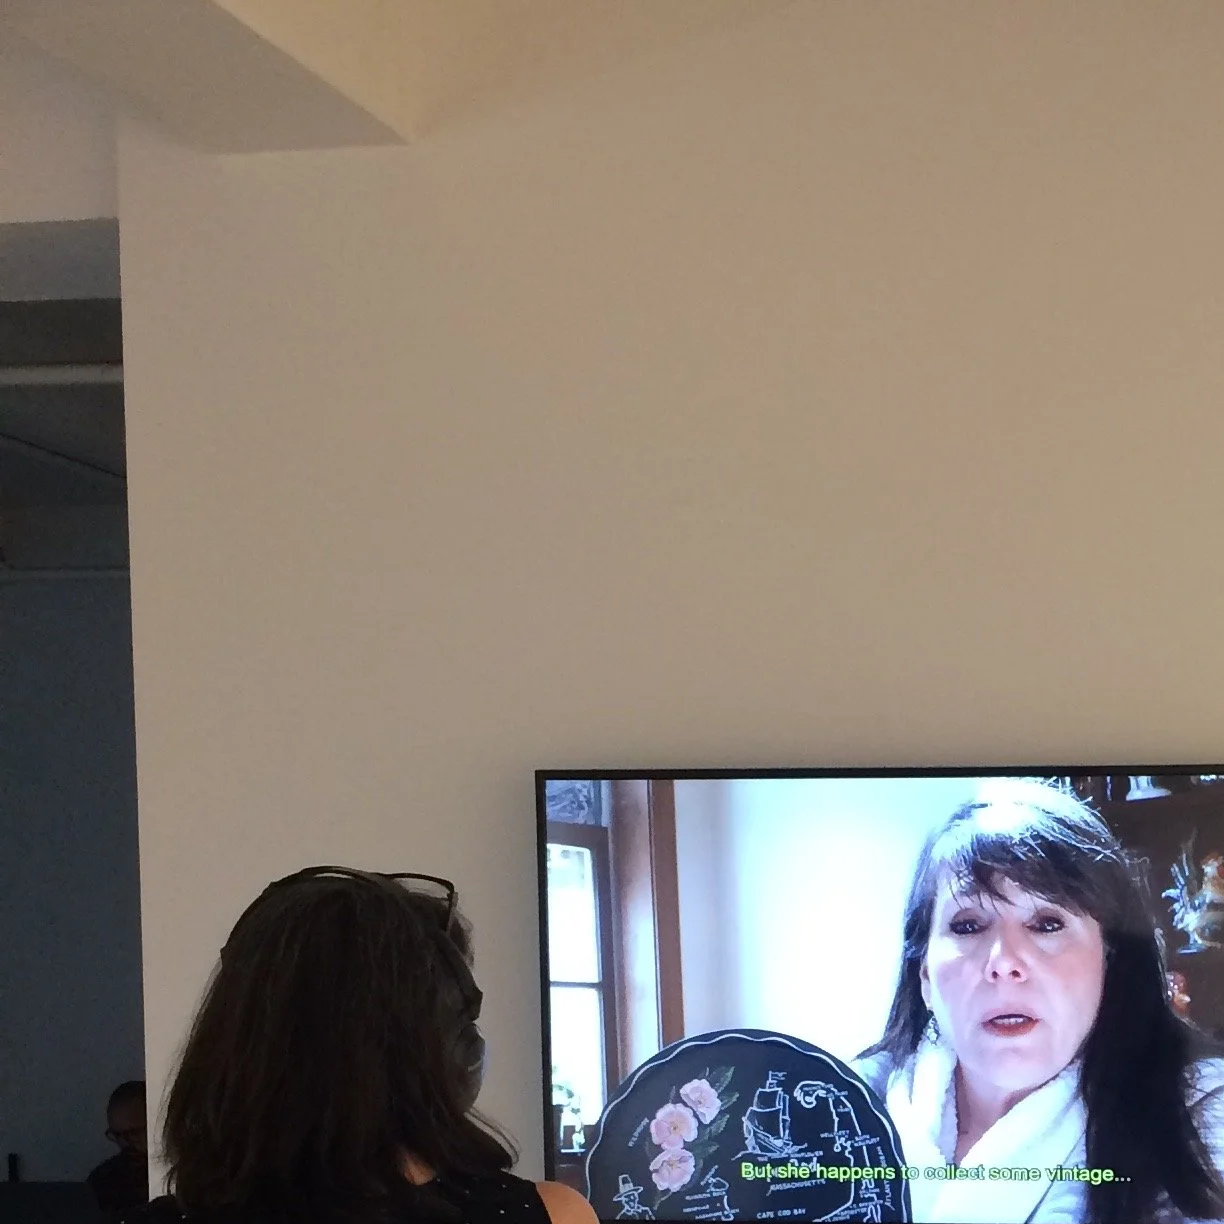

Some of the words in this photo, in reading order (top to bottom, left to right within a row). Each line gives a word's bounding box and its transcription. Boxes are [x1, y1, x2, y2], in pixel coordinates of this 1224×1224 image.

[741, 1163, 772, 1179] But
[777, 1163, 811, 1179] she
[816, 1163, 896, 1183] happens
[901, 1165, 918, 1180] to
[923, 1164, 985, 1181] collect
[988, 1168, 1041, 1181] some
[1046, 1165, 1132, 1184] vintage...
[777, 1209, 791, 1217] COD
